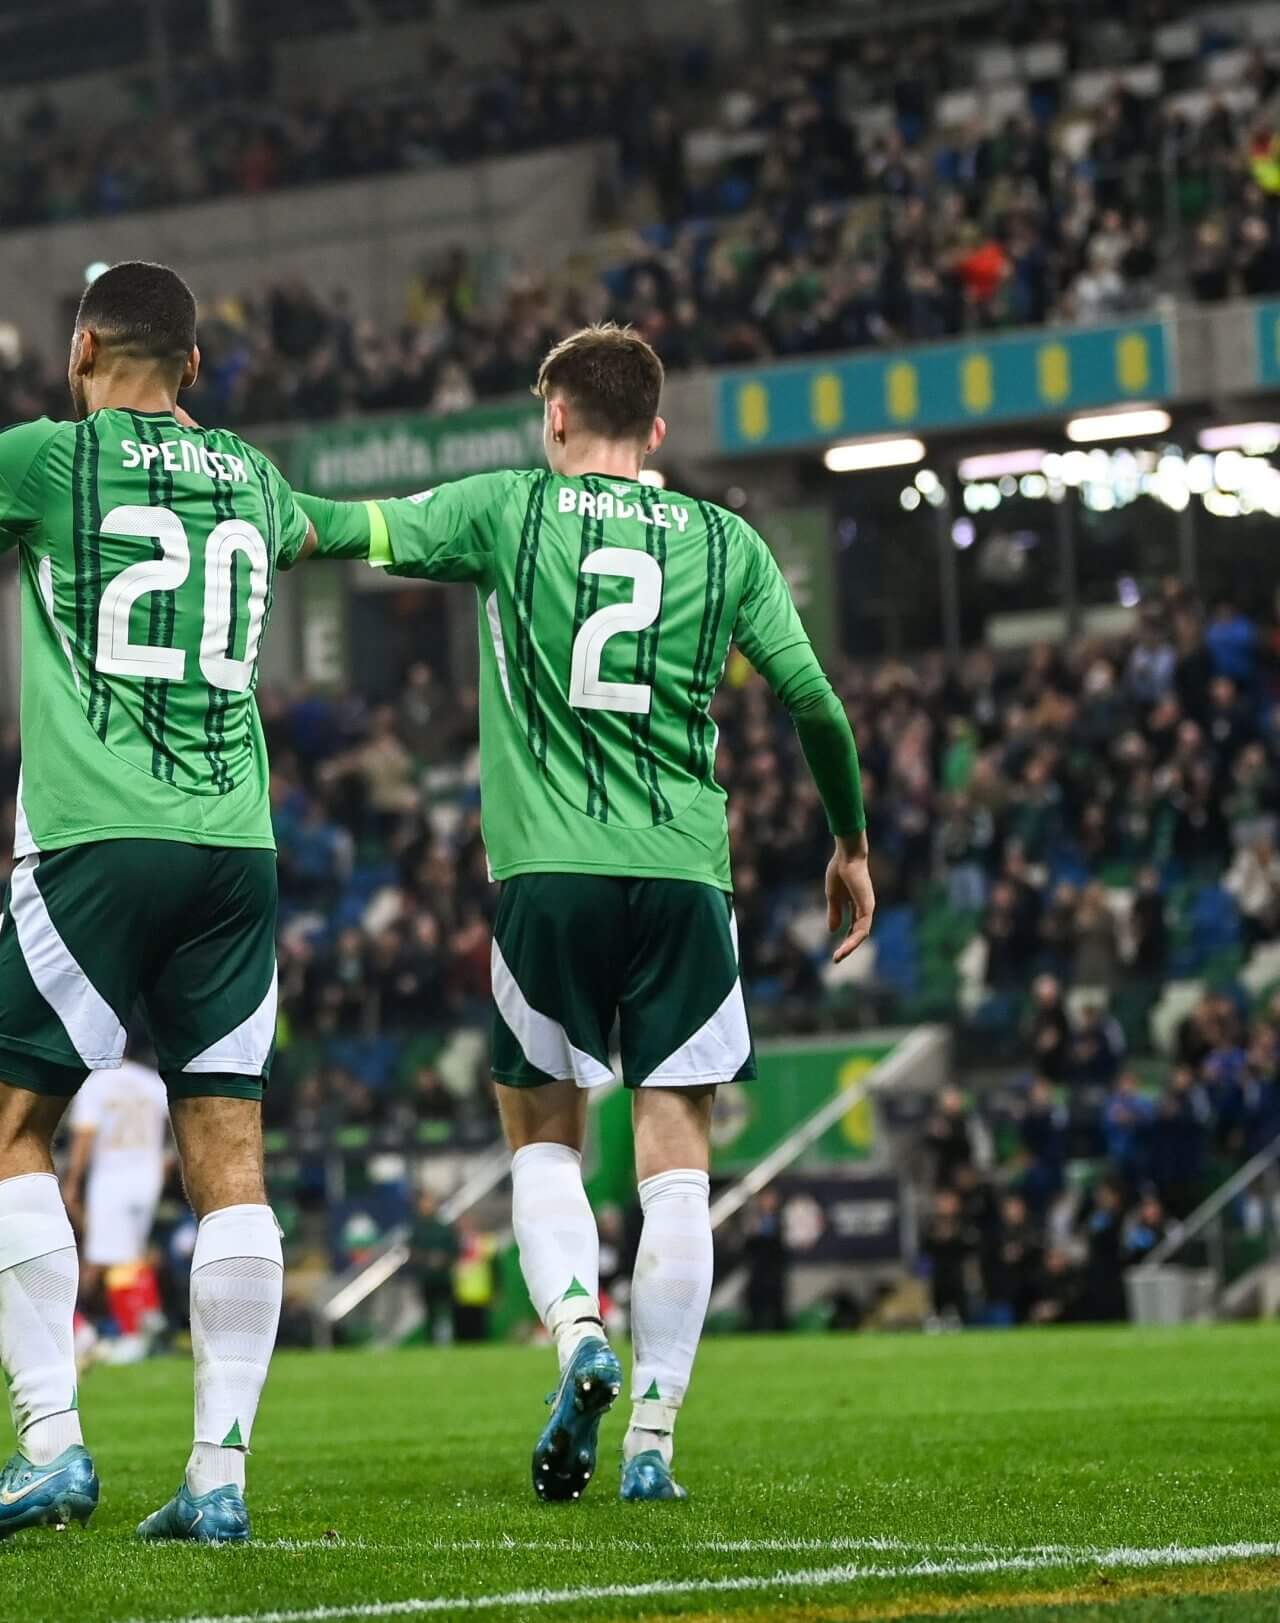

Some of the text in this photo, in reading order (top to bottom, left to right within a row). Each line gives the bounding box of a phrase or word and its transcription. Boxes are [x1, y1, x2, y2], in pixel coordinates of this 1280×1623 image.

[120, 438, 248, 484] SPENCER
[558, 486, 689, 532] BRADLEY
[95, 505, 268, 693] 20
[569, 547, 663, 714] 2
